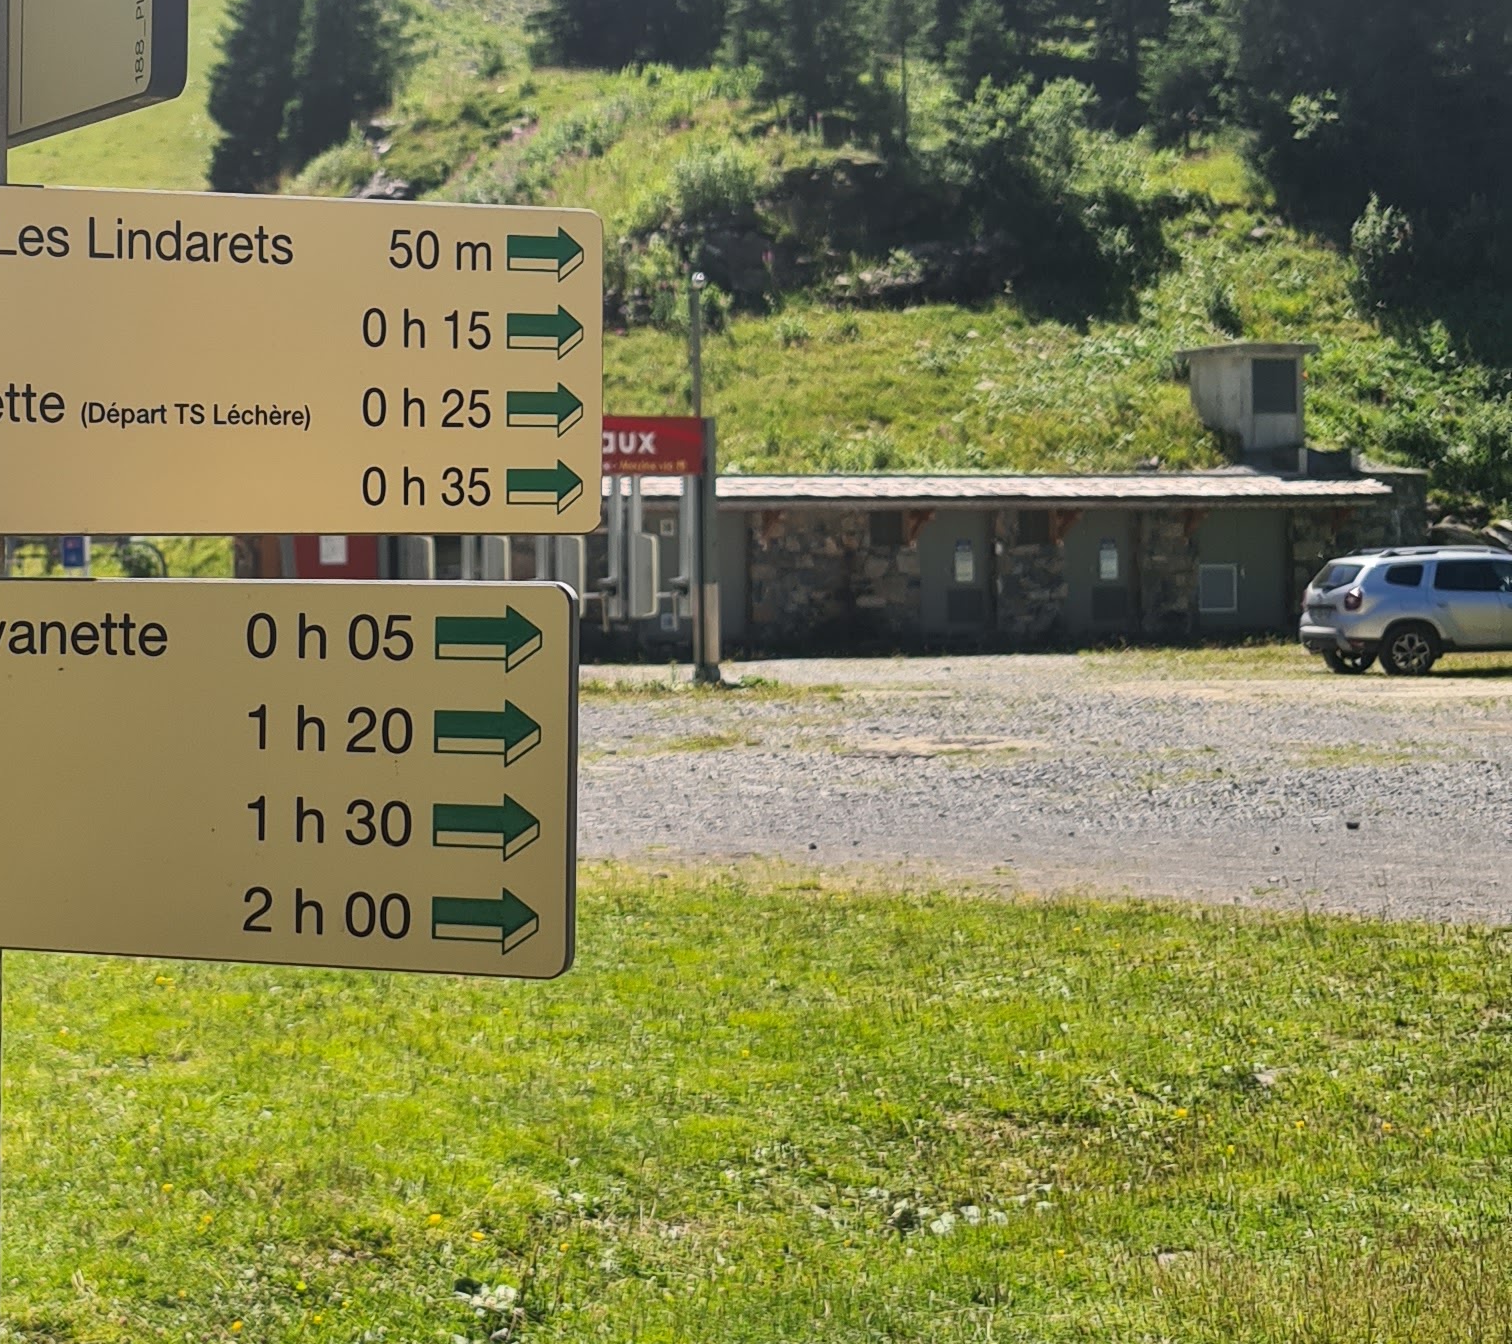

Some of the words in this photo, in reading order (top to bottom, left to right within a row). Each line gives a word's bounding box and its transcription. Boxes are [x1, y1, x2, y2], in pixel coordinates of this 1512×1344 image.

[88, 216, 294, 266] Lindarets
[388, 229, 440, 270] 50
[456, 241, 492, 272] m
[362, 307, 387, 348] 0
[403, 307, 426, 349] h
[444, 309, 492, 351] 15
[80, 401, 168, 430] (Départ
[173, 403, 206, 425] TS
[213, 403, 311, 432] Léchère)
[362, 387, 387, 428] 0
[403, 387, 426, 428] h
[441, 388, 491, 429] 25
[362, 466, 387, 507] 0
[403, 465, 425, 506] h
[441, 466, 491, 507] 35
[246, 612, 277, 659] 0
[298, 612, 327, 660] h
[348, 613, 414, 662] 05
[248, 703, 267, 750] 1
[296, 704, 326, 752] h
[345, 706, 413, 755] 20
[247, 795, 266, 842] 1
[296, 796, 325, 844] h
[345, 798, 412, 848] 30
[242, 886, 273, 933] 2
[295, 887, 324, 936] h
[345, 890, 411, 940] 00
